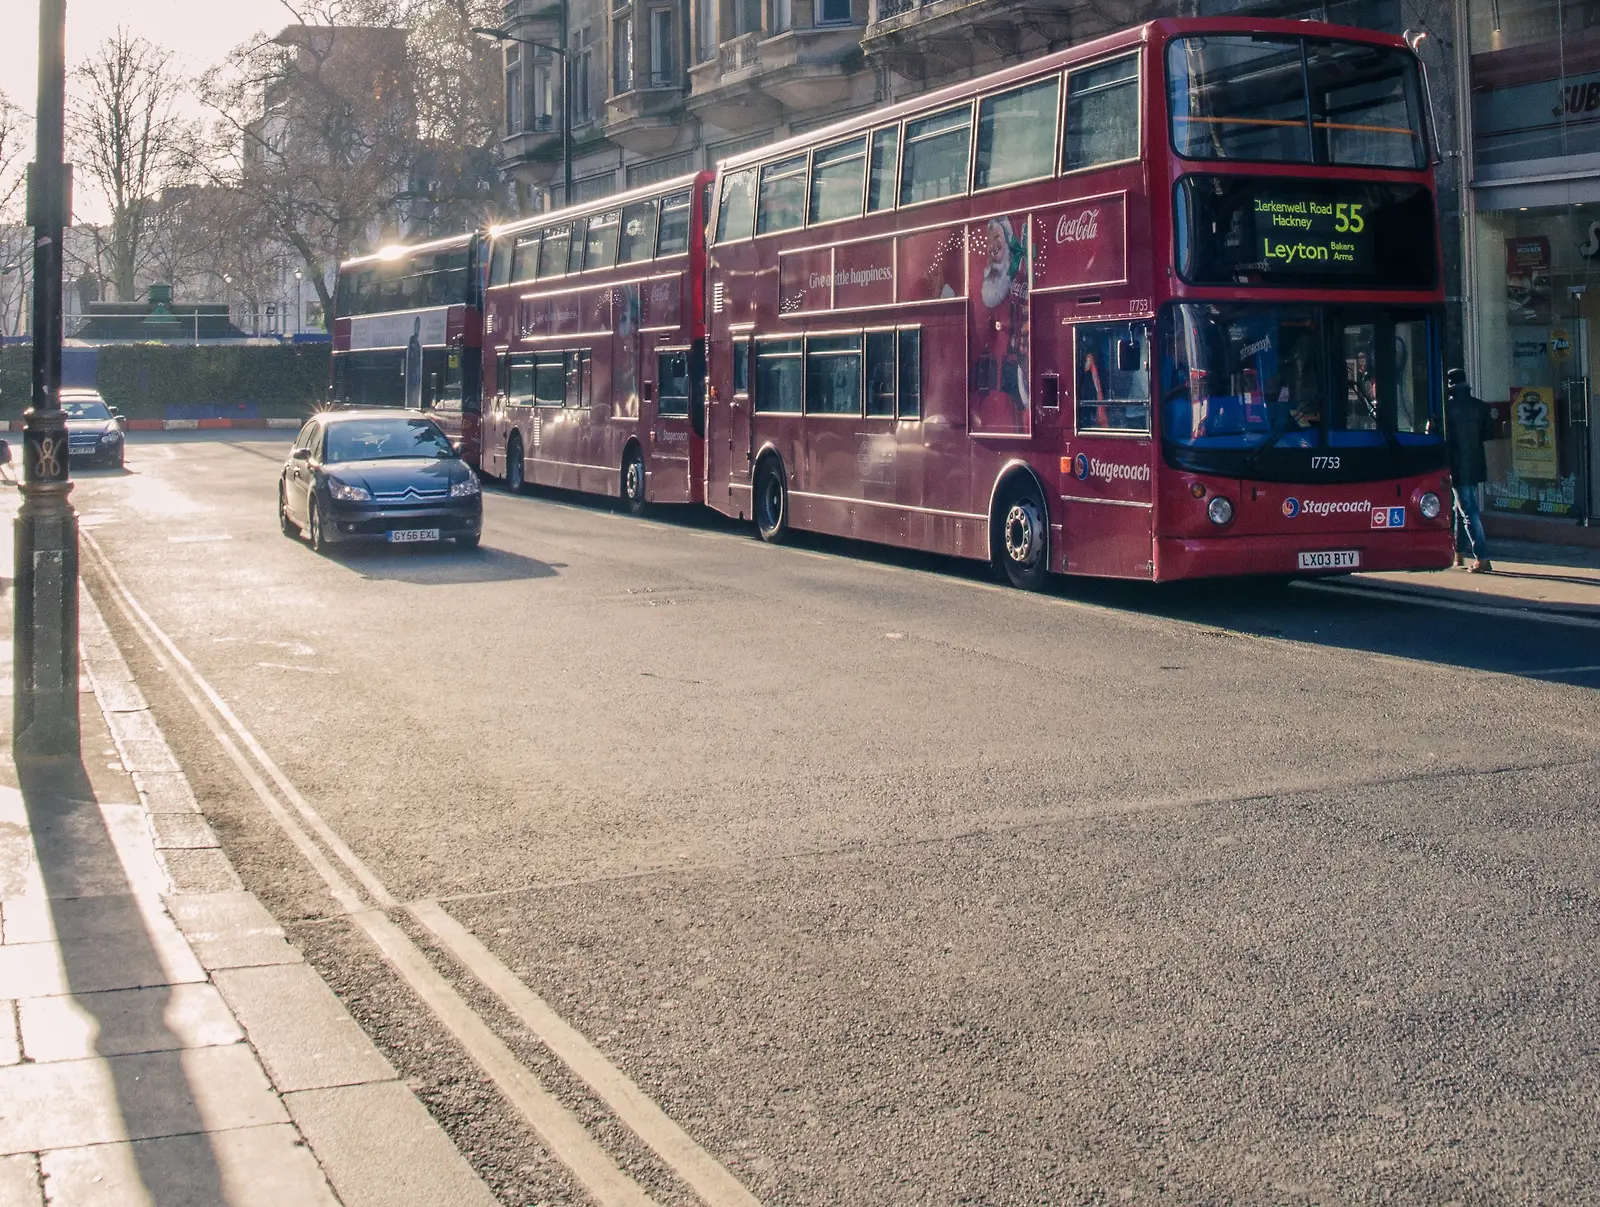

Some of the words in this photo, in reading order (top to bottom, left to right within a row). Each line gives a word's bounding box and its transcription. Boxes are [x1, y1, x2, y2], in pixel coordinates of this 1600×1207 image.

[1552, 83, 1600, 117] SUB
[1310, 202, 1333, 215] Road
[1272, 214, 1313, 230] Hackney
[1335, 203, 1364, 233] 55
[1264, 238, 1328, 264] Leyton
[1330, 241, 1355, 251] Bakers
[1333, 252, 1354, 261] Arms
[809, 272, 826, 289] Give
[1129, 299, 1148, 312] 17753
[1517, 402, 1549, 426] £2
[1090, 458, 1150, 483] Stagecoach
[1311, 456, 1341, 469] 17753
[1301, 500, 1371, 517] Stagecoach
[394, 531, 418, 541] GY56
[420, 530, 438, 540] EXL
[1302, 553, 1332, 567] LX03
[1334, 552, 1355, 566] BTV
